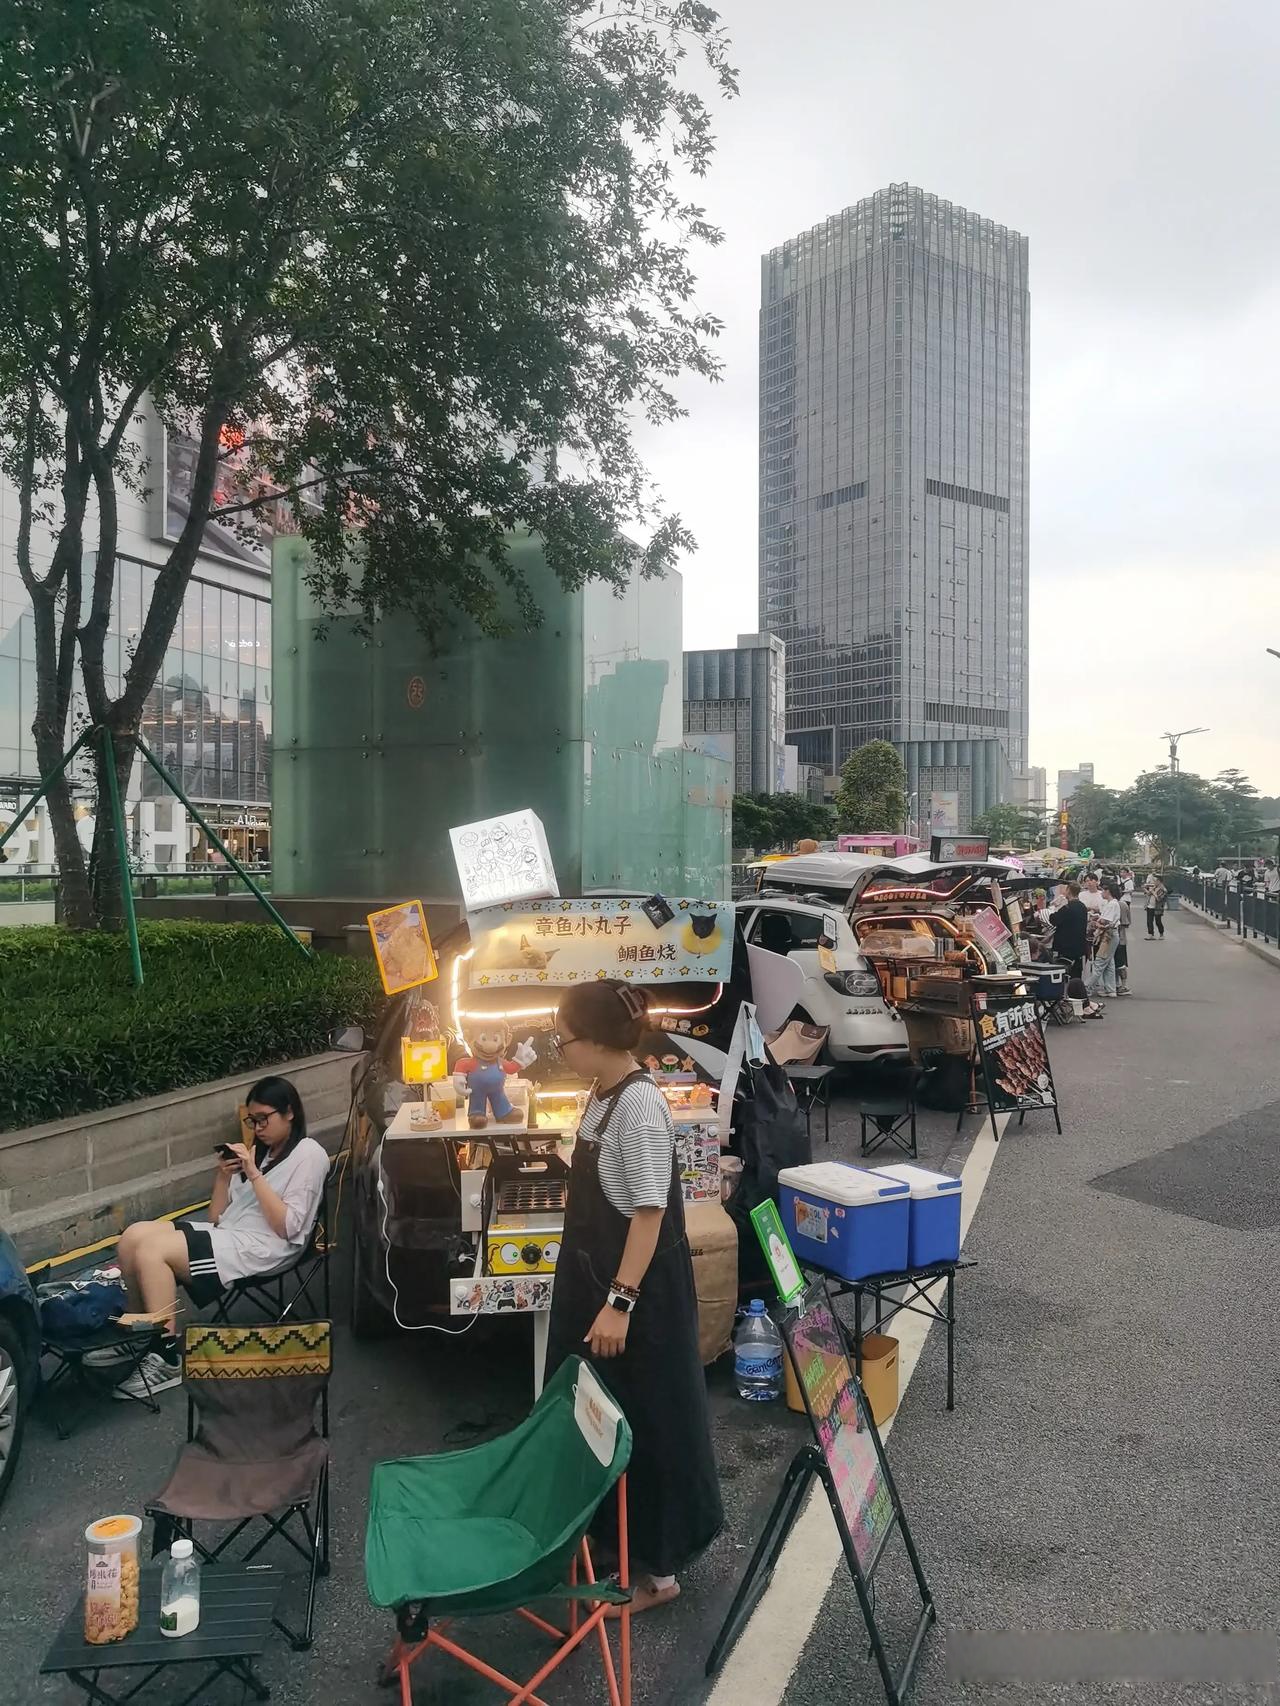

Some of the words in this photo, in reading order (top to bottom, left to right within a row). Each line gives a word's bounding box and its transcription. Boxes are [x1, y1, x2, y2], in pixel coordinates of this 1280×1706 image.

[535, 915, 632, 937] 章鱼小丸子
[617, 944, 676, 963] 鲷鱼烧
